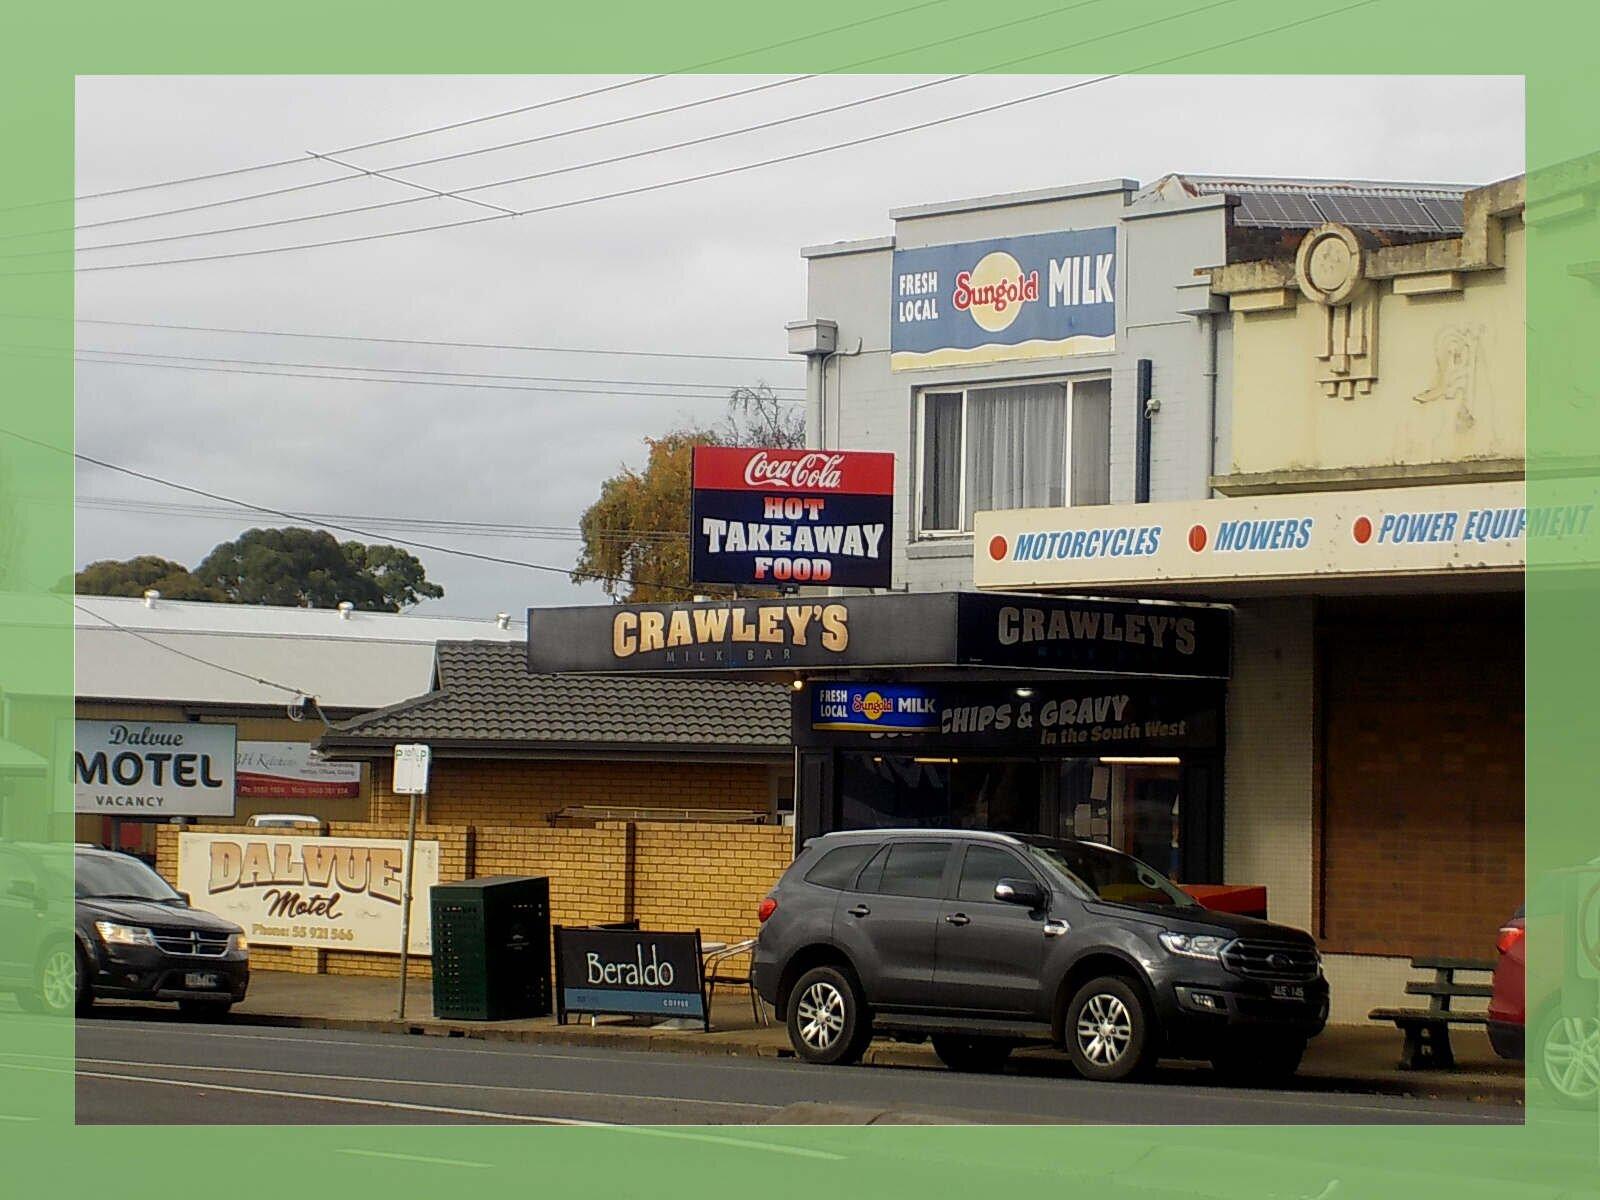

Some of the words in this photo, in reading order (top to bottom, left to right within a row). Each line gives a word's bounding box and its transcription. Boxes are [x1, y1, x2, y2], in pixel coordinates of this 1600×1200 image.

[899, 271, 938, 296] FRESH
[953, 270, 1039, 312] Sungold
[1049, 253, 1114, 307] MILK
[899, 299, 938, 323] LOCAL
[745, 451, 845, 488] Coca-Cola
[764, 496, 825, 520] HOT
[703, 517, 884, 558] TAKEAWAY
[1013, 526, 1162, 561] MOTORCYCLES
[1214, 518, 1313, 551] MOWERS
[1377, 512, 1459, 544] POWER
[754, 557, 832, 581] FOOD
[613, 604, 849, 657] CRAWLEY'S
[998, 606, 1196, 655] CRAWLEY'S
[666, 651, 723, 662] MILK
[747, 649, 792, 661] BAR
[820, 689, 848, 702] FRESH
[820, 705, 848, 717] LOCAL
[852, 693, 894, 714] Sungold
[898, 698, 936, 713] MILK
[941, 703, 1012, 734] CHIPS
[1017, 702, 1032, 729] &
[1039, 695, 1130, 727] GRAVY
[108, 724, 184, 747] Dalvue
[1060, 728, 1088, 743] the
[1091, 722, 1140, 742] South
[1145, 720, 1186, 737] West
[68, 751, 223, 788] MOTEL
[95, 795, 165, 807] VACANCY
[208, 841, 402, 905] DALVUE
[263, 889, 343, 920] Motel
[252, 924, 289, 938] Phone:
[292, 926, 307, 938] 55
[310, 926, 328, 939] 921
[331, 928, 354, 941] 566
[587, 943, 674, 986] Beraldo
